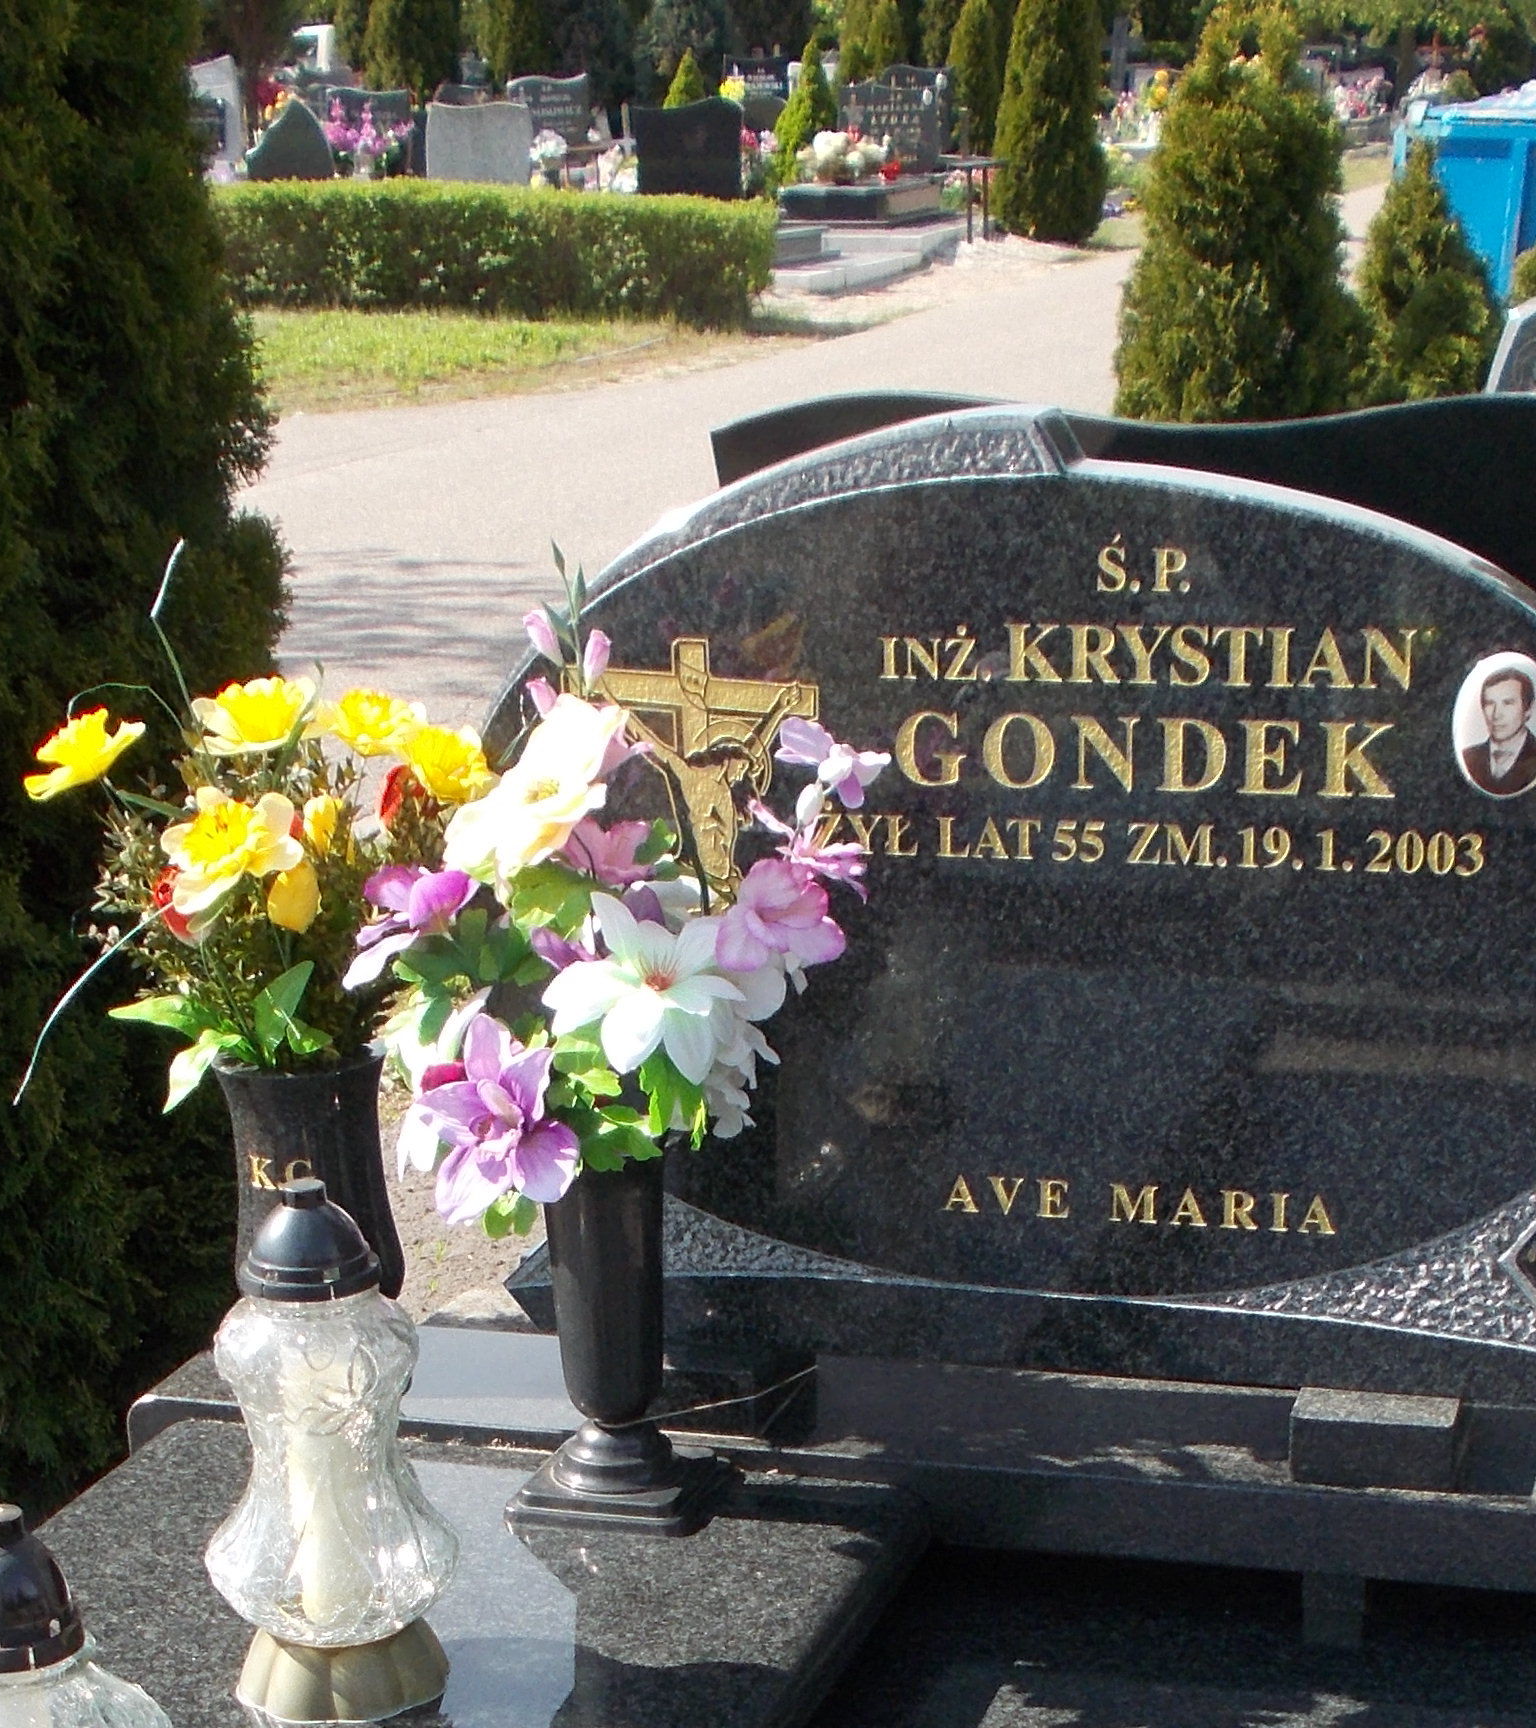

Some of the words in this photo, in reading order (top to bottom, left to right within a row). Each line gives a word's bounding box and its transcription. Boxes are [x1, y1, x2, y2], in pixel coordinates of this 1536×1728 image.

[878, 624, 992, 682] INŻ.
[1004, 622, 1418, 692] KRYSTIAN
[895, 710, 1398, 800] GONDEK
[811, 800, 919, 857] ŻYŁ
[935, 815, 1041, 860] LAT
[1051, 820, 1106, 863] 55
[942, 1174, 1070, 1219] AVE
[1108, 1182, 1336, 1236] MARIA
